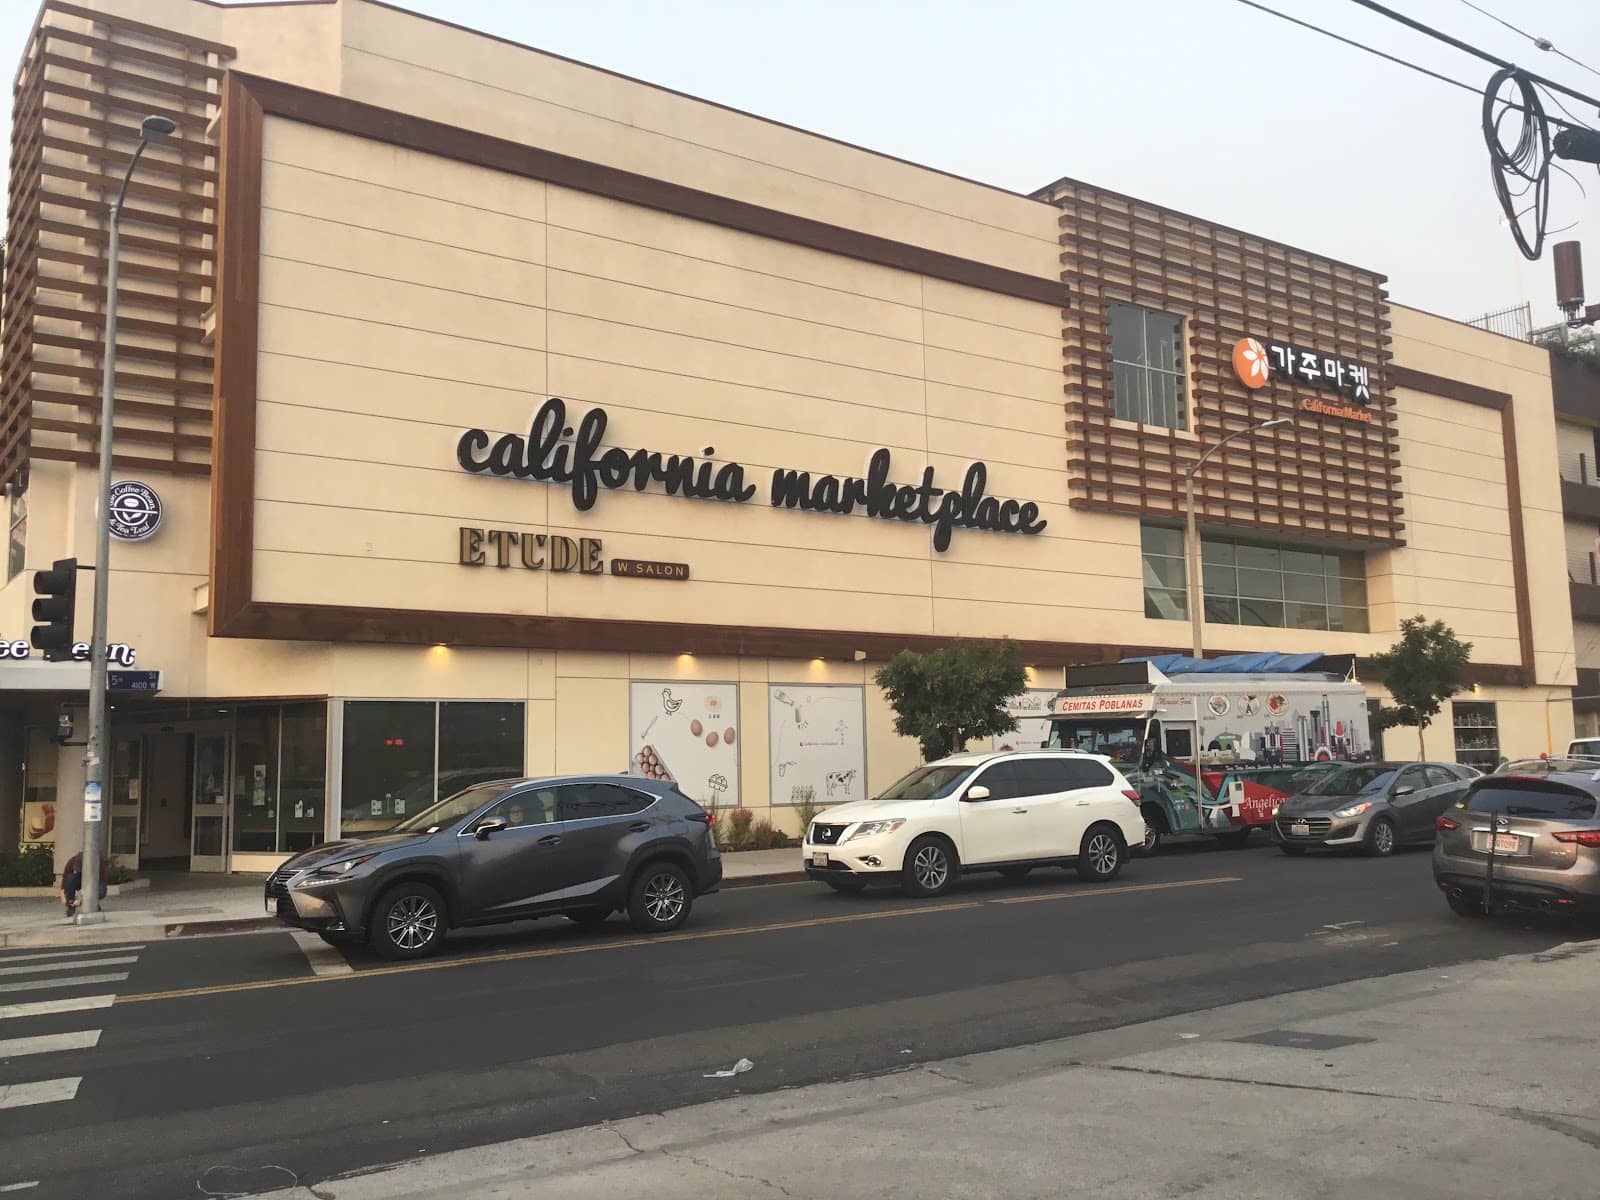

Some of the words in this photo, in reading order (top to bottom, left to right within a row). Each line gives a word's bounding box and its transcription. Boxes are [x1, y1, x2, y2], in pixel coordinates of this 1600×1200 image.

[1271, 346, 1370, 399] 가주마켓
[457, 398, 756, 511] california
[771, 448, 1047, 552] marketplace
[459, 527, 604, 575] ETUDE
[617, 561, 629, 573] W
[636, 563, 684, 577] SALON
[1062, 700, 1097, 712] CEMITAS
[1099, 698, 1144, 710] POBLANAS
